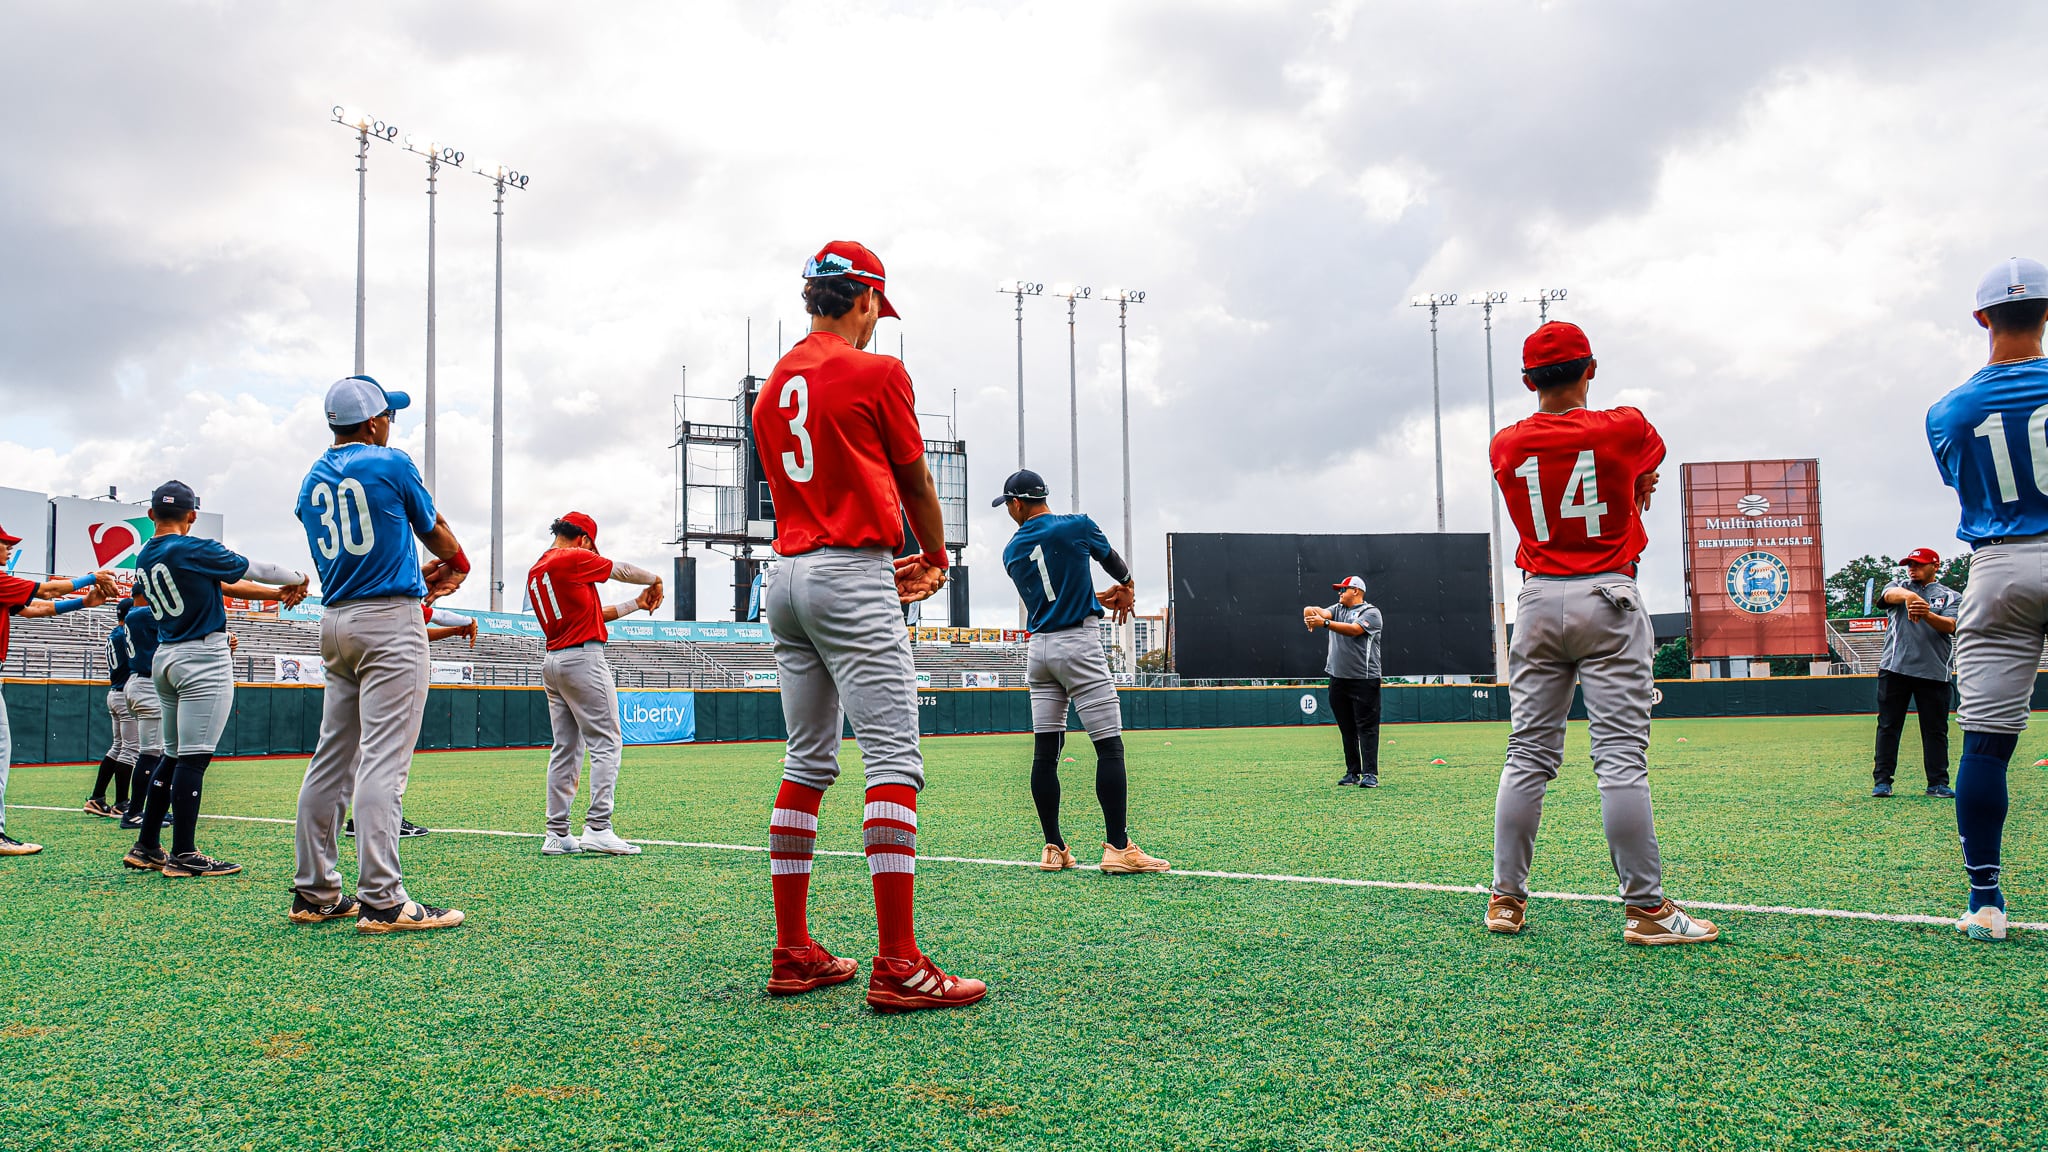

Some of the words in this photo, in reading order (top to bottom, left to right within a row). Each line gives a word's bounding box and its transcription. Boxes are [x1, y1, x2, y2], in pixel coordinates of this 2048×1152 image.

[778, 375, 814, 482] 3
[1515, 449, 1608, 541] 14
[312, 478, 374, 559] 30
[1706, 516, 1803, 530] Multinational
[1698, 538, 1754, 548] BIENVENIDOS
[1756, 538, 1763, 546] A
[1765, 538, 1776, 546] LA
[1778, 537, 1800, 545] CASA
[1802, 537, 1813, 545] DE
[136, 563, 184, 620] 30
[1029, 544, 1057, 602] 1
[530, 571, 562, 624] 11
[917, 696, 937, 706] 375
[1305, 699, 1313, 709] 12
[1472, 689, 1489, 699] 404
[623, 703, 685, 727] Liberty
